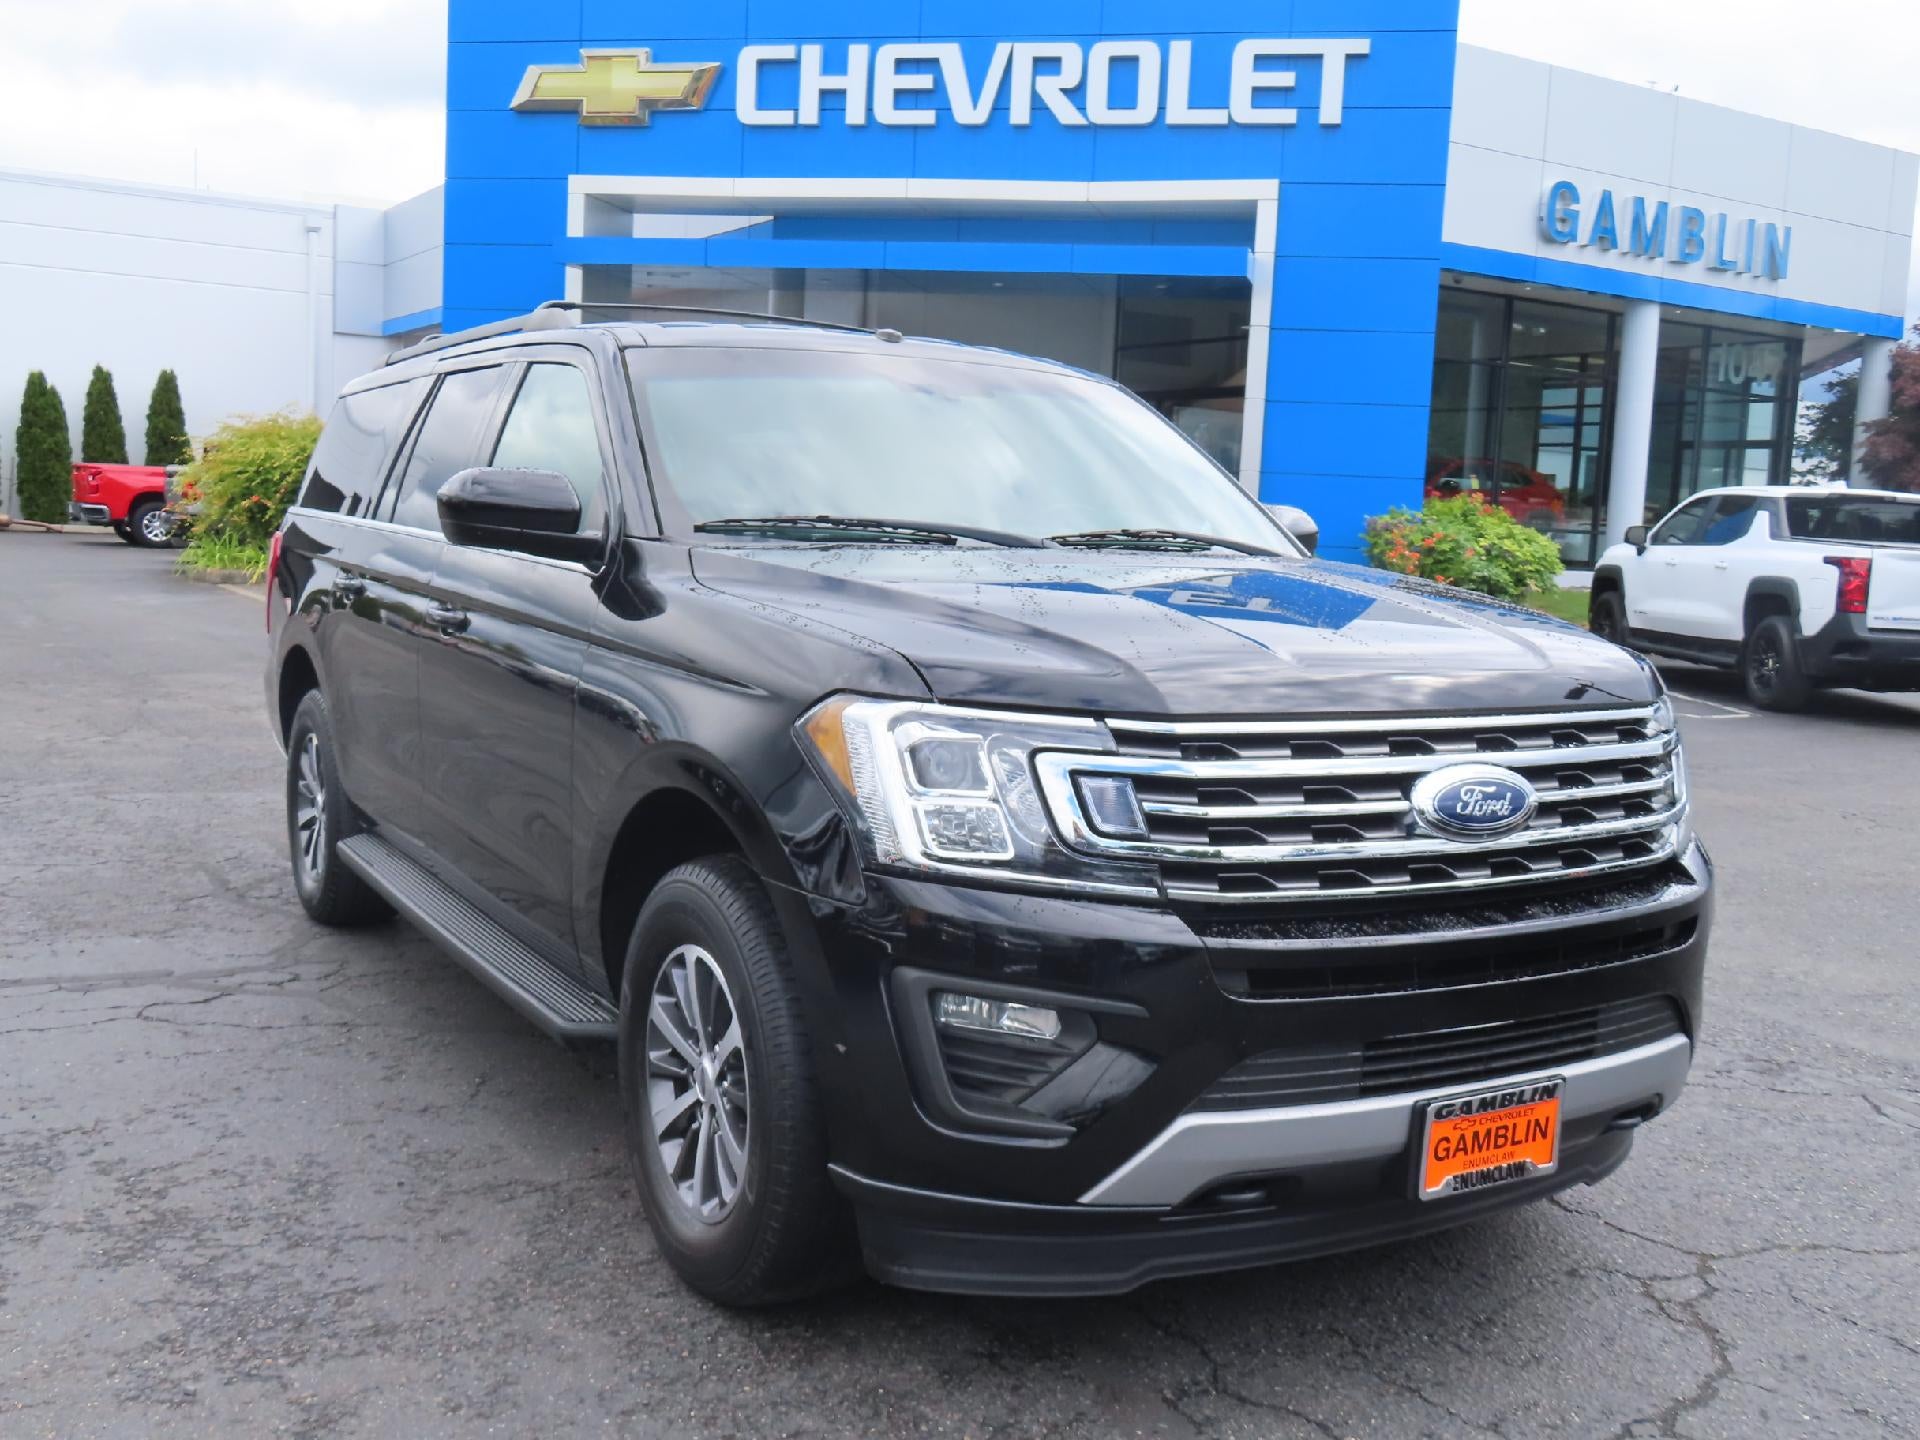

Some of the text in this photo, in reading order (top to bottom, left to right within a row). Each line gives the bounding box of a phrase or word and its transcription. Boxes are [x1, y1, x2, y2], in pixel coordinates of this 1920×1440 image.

[737, 38, 1371, 127] CHEVROLET
[1542, 181, 1791, 280] GAMBLIN
[1456, 785, 1513, 817] Ford
[1434, 1083, 1558, 1120] GAMBLIN
[1479, 1107, 1536, 1126] CHEVROLET
[1433, 1116, 1549, 1162] GAMBLIN
[1452, 1161, 1526, 1192] ENUMCLAW
[1463, 1151, 1515, 1170] ENUMCLAW
